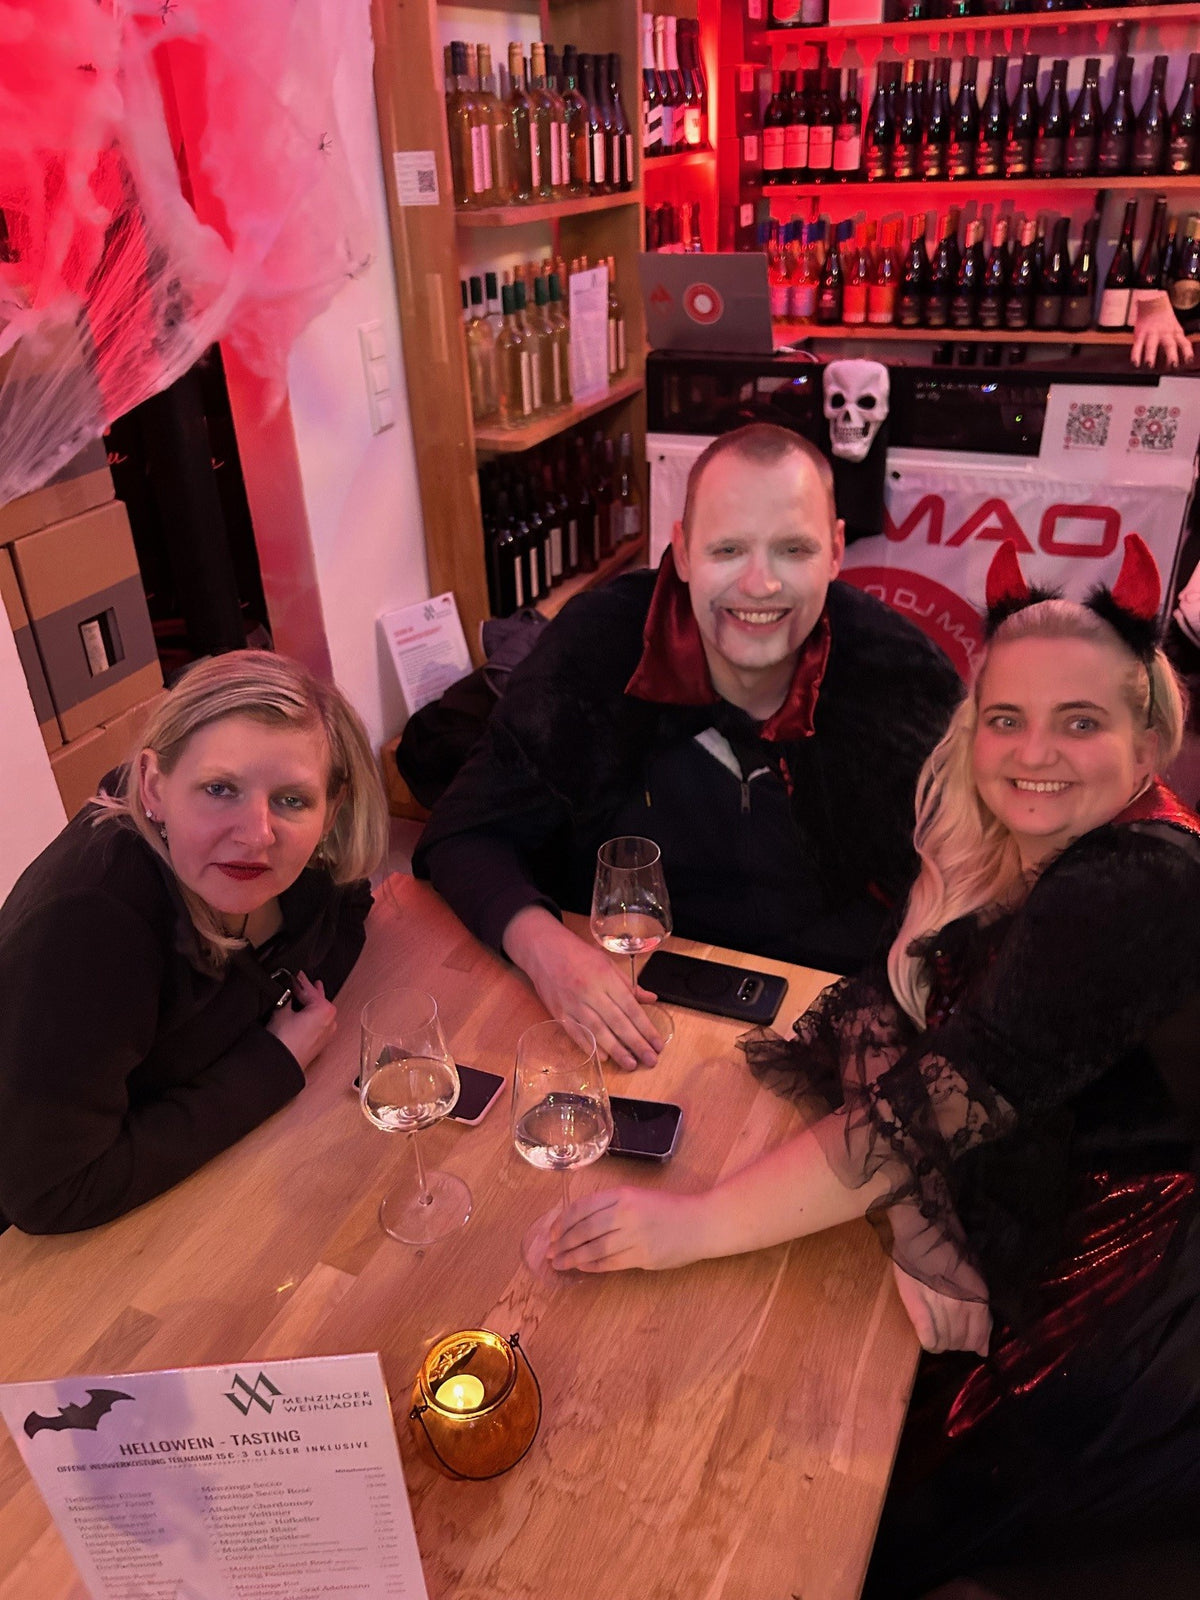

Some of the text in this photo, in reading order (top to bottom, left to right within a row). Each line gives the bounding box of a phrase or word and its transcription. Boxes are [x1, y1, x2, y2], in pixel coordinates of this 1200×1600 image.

[282, 1391, 371, 1405] MENZINGER
[284, 1400, 373, 1413] WEINLADEN
[119, 1436, 215, 1456] HELLOWEIN
[230, 1430, 301, 1447] TASTING
[57, 1464, 87, 1473] OFFENE
[306, 1441, 369, 1452] INKLUSIVE
